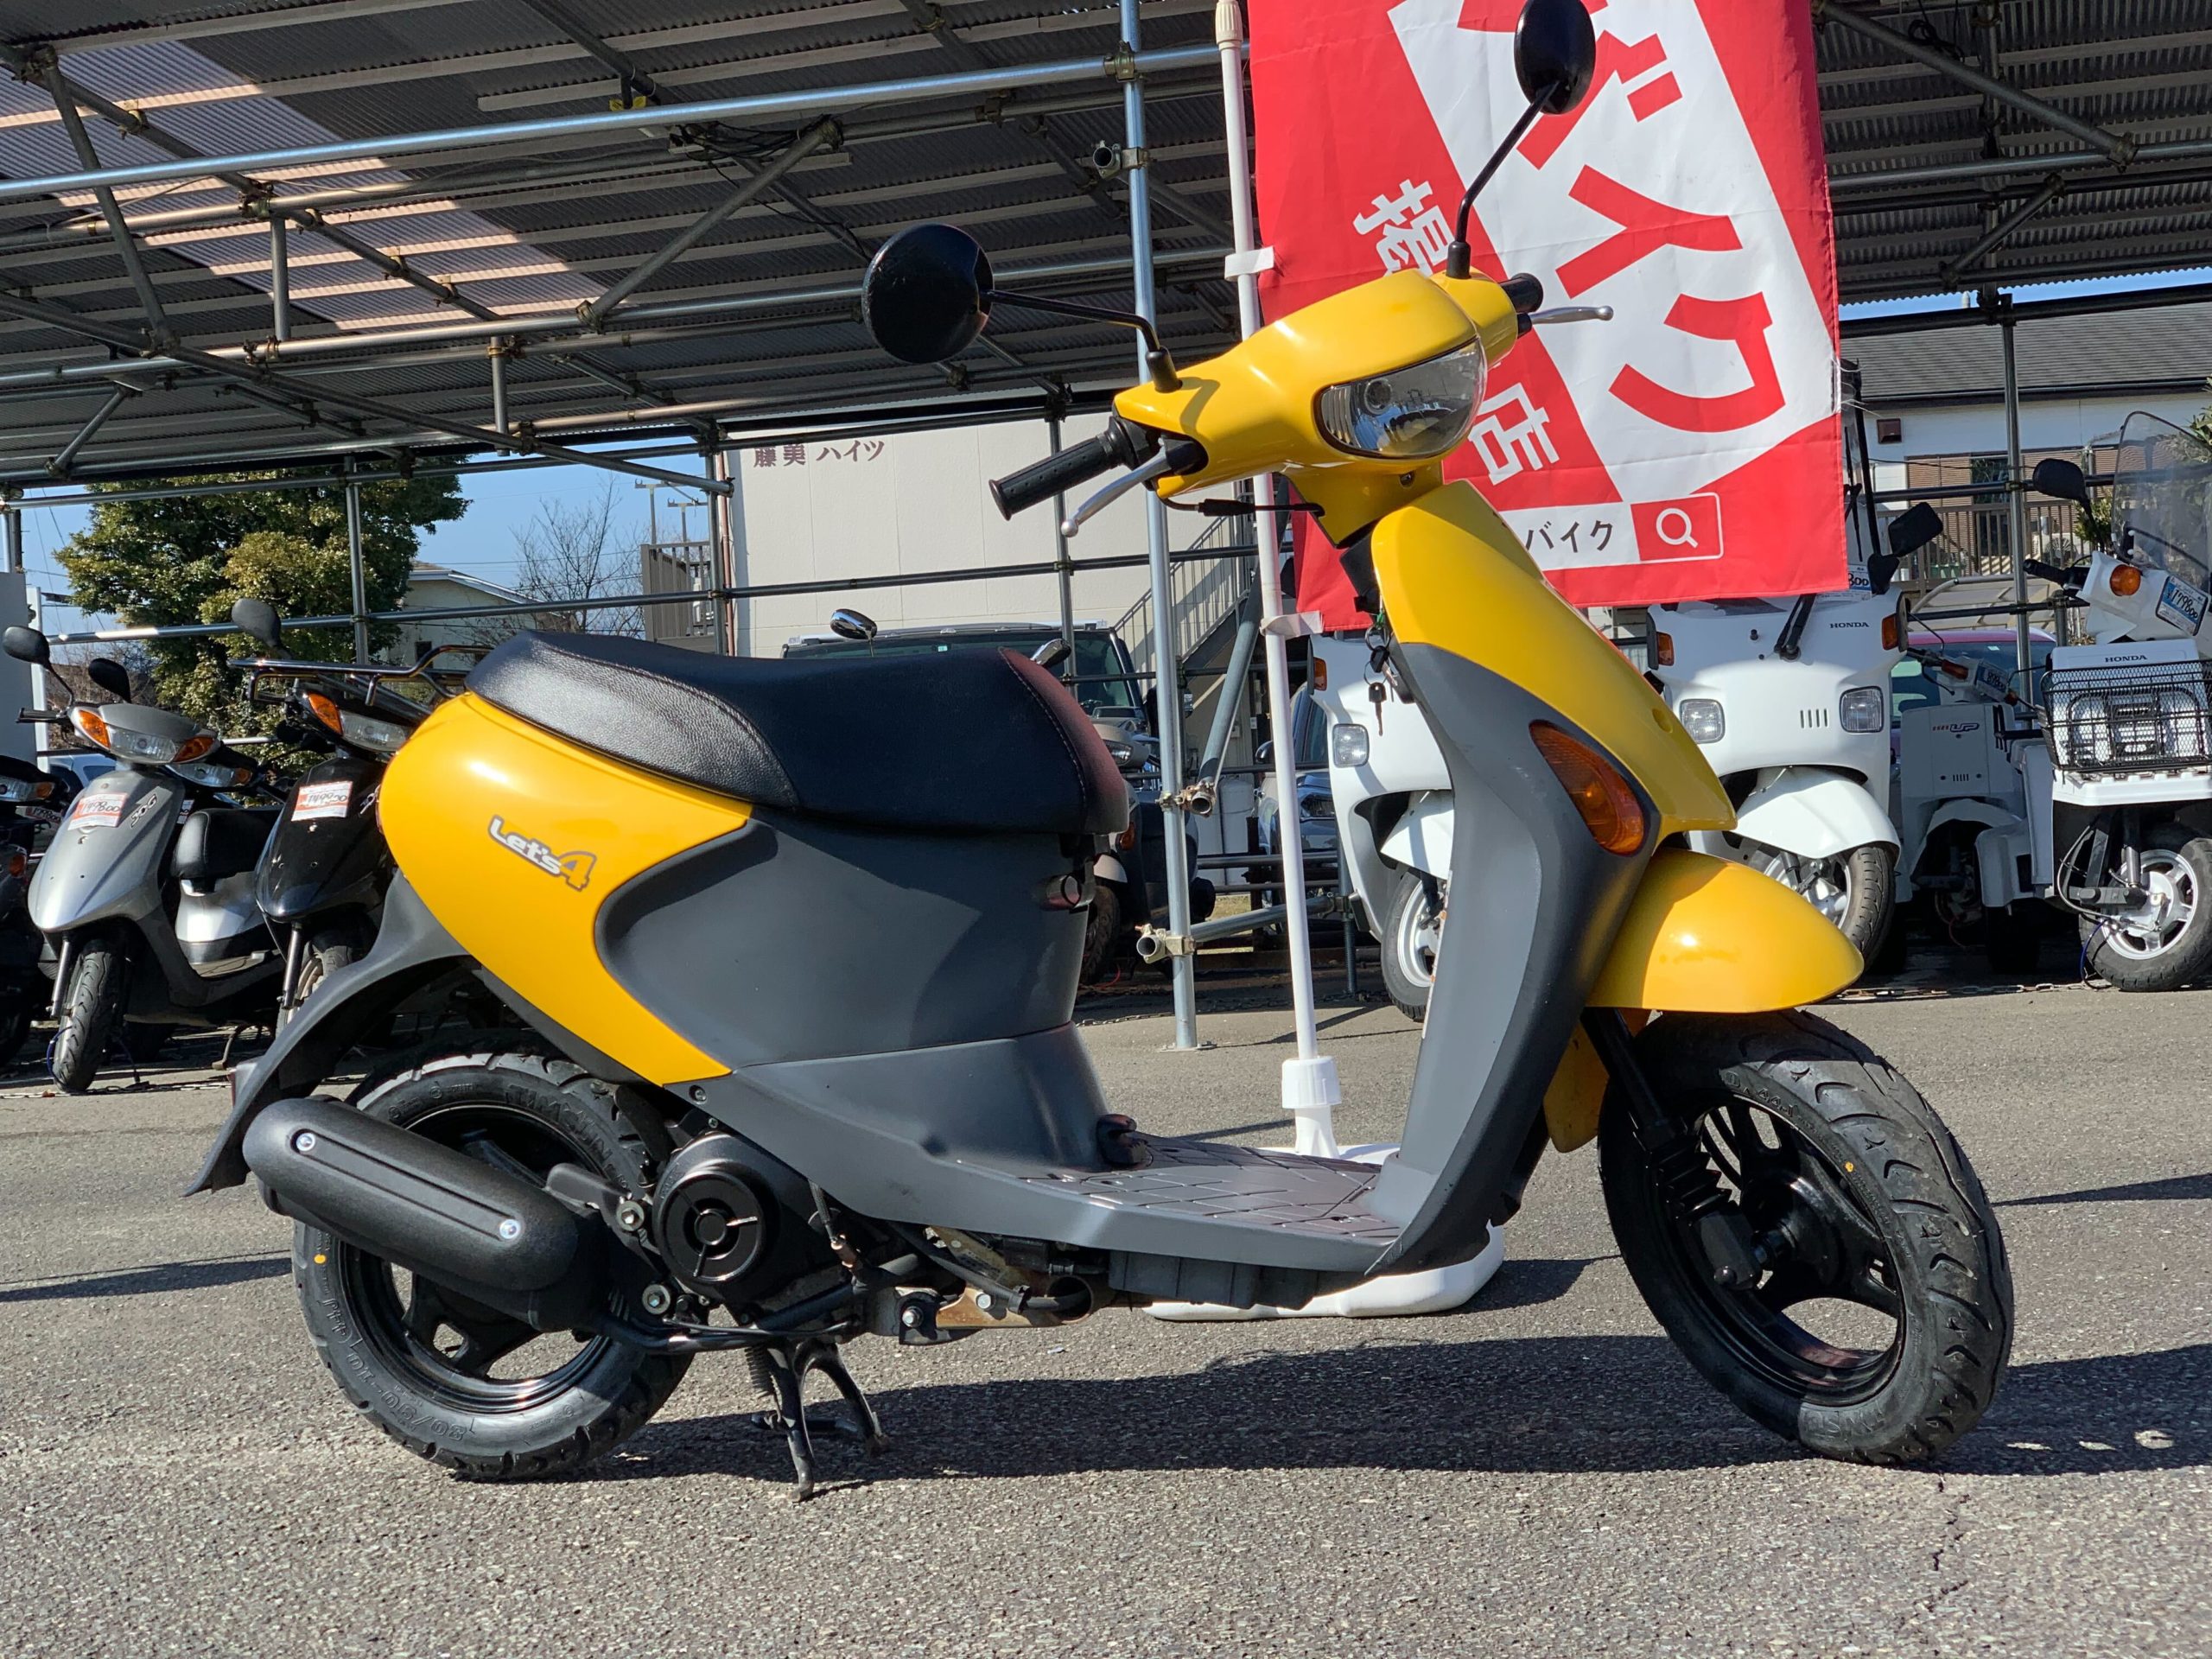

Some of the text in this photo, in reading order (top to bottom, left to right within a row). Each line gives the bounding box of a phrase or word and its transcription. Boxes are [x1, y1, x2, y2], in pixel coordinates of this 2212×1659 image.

[1353, 179, 1560, 486] 掲店
[1525, 520, 1613, 553] バイク
